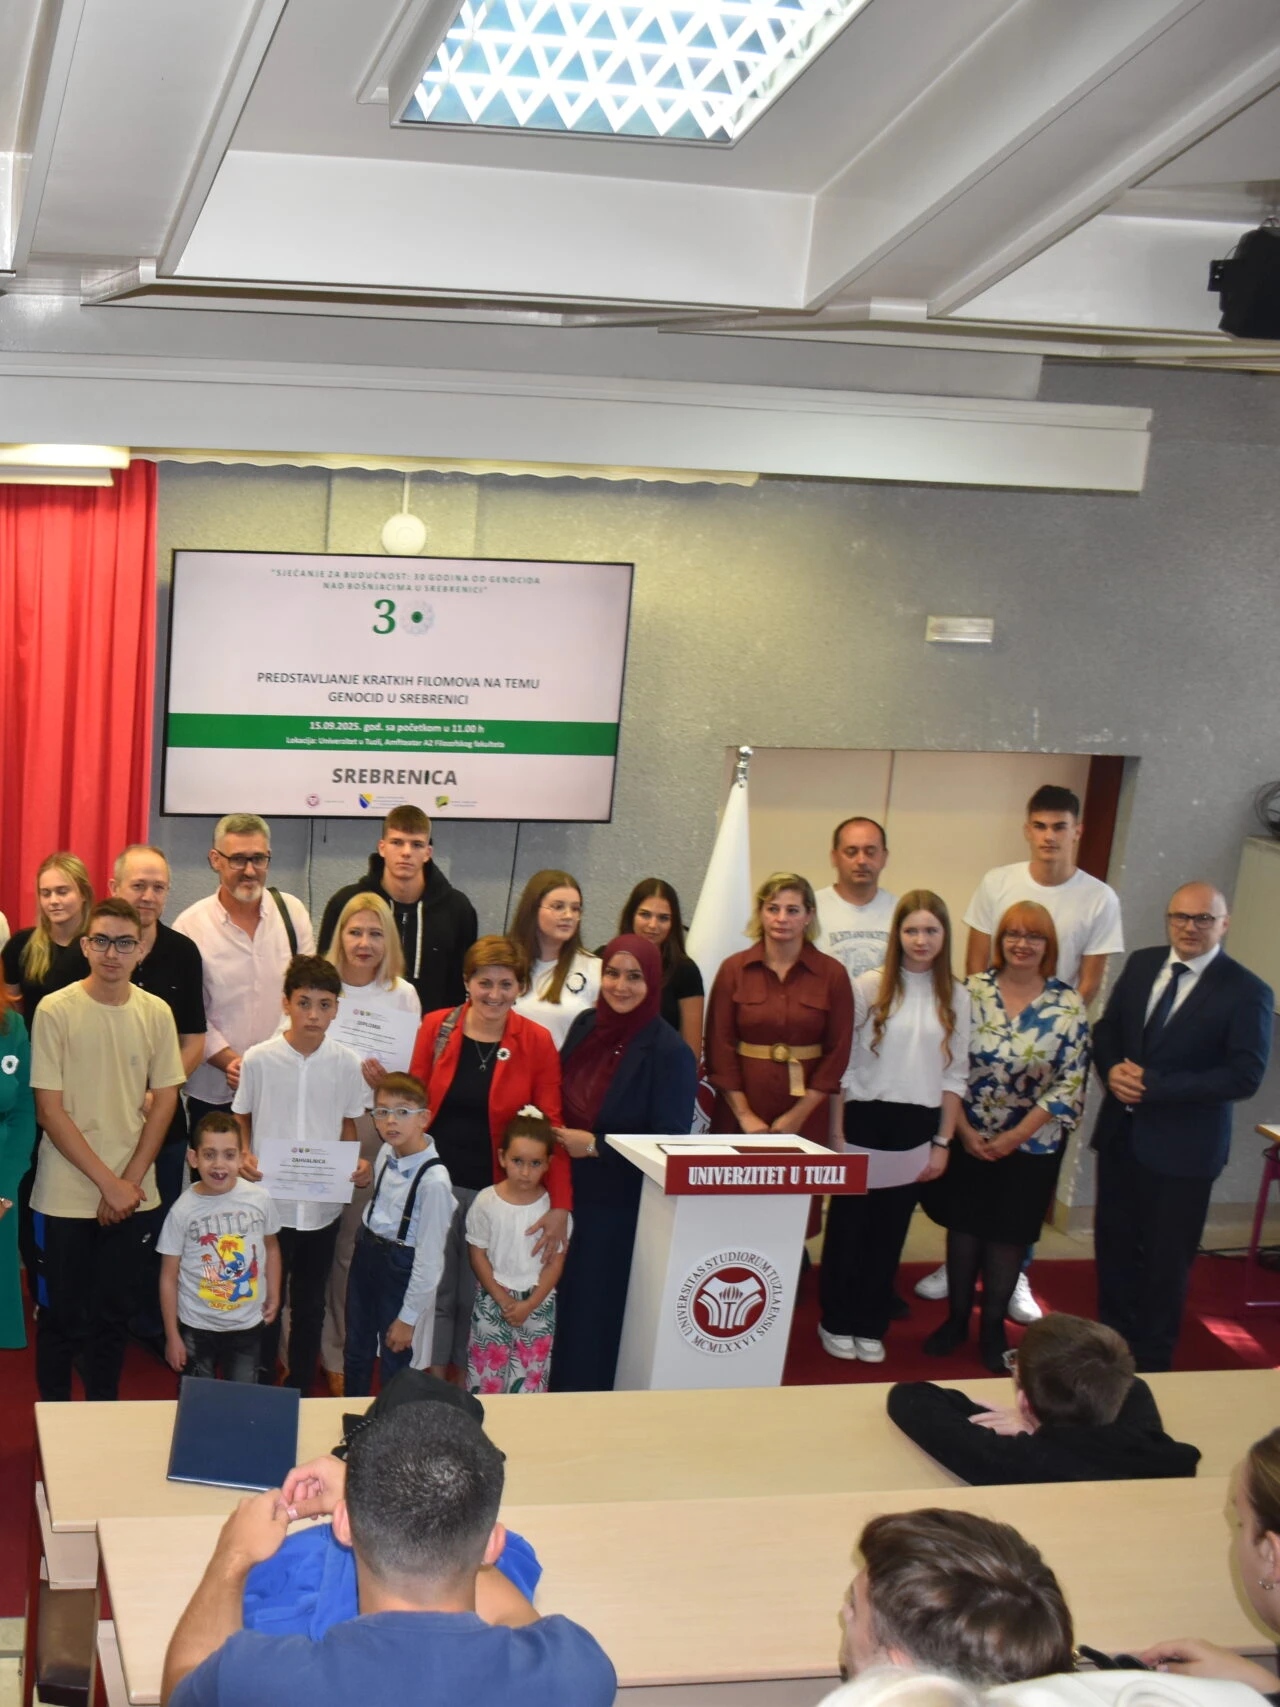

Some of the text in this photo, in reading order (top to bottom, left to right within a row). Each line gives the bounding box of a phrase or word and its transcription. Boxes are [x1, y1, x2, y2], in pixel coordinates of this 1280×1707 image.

[323, 581, 344, 590] NAD
[327, 570, 340, 578] ZA
[428, 573, 468, 582] GODINA
[471, 575, 487, 583] OD
[488, 576, 540, 585] GENOCIDA
[257, 672, 540, 690] PREDSTAVLJANJE KRATKIH FILOMOVA NA TEMU
[328, 691, 469, 705] GENOCID U SREBRENICI
[310, 721, 362, 731] 15.09.2025.
[363, 723, 384, 733] god.
[385, 724, 396, 732] sa
[443, 725, 450, 733] u
[452, 724, 477, 733] 11.00
[477, 724, 485, 734] h
[332, 768, 458, 785] SREBRENICA
[688, 1166, 846, 1185] UNIVERZITET U TUZLI
[189, 1210, 265, 1242] STITCH
[677, 1251, 783, 1337] UNIVERSITAS STUDIORUM TUZLAENSIS
[692, 1333, 757, 1354] MCMLXXVI
